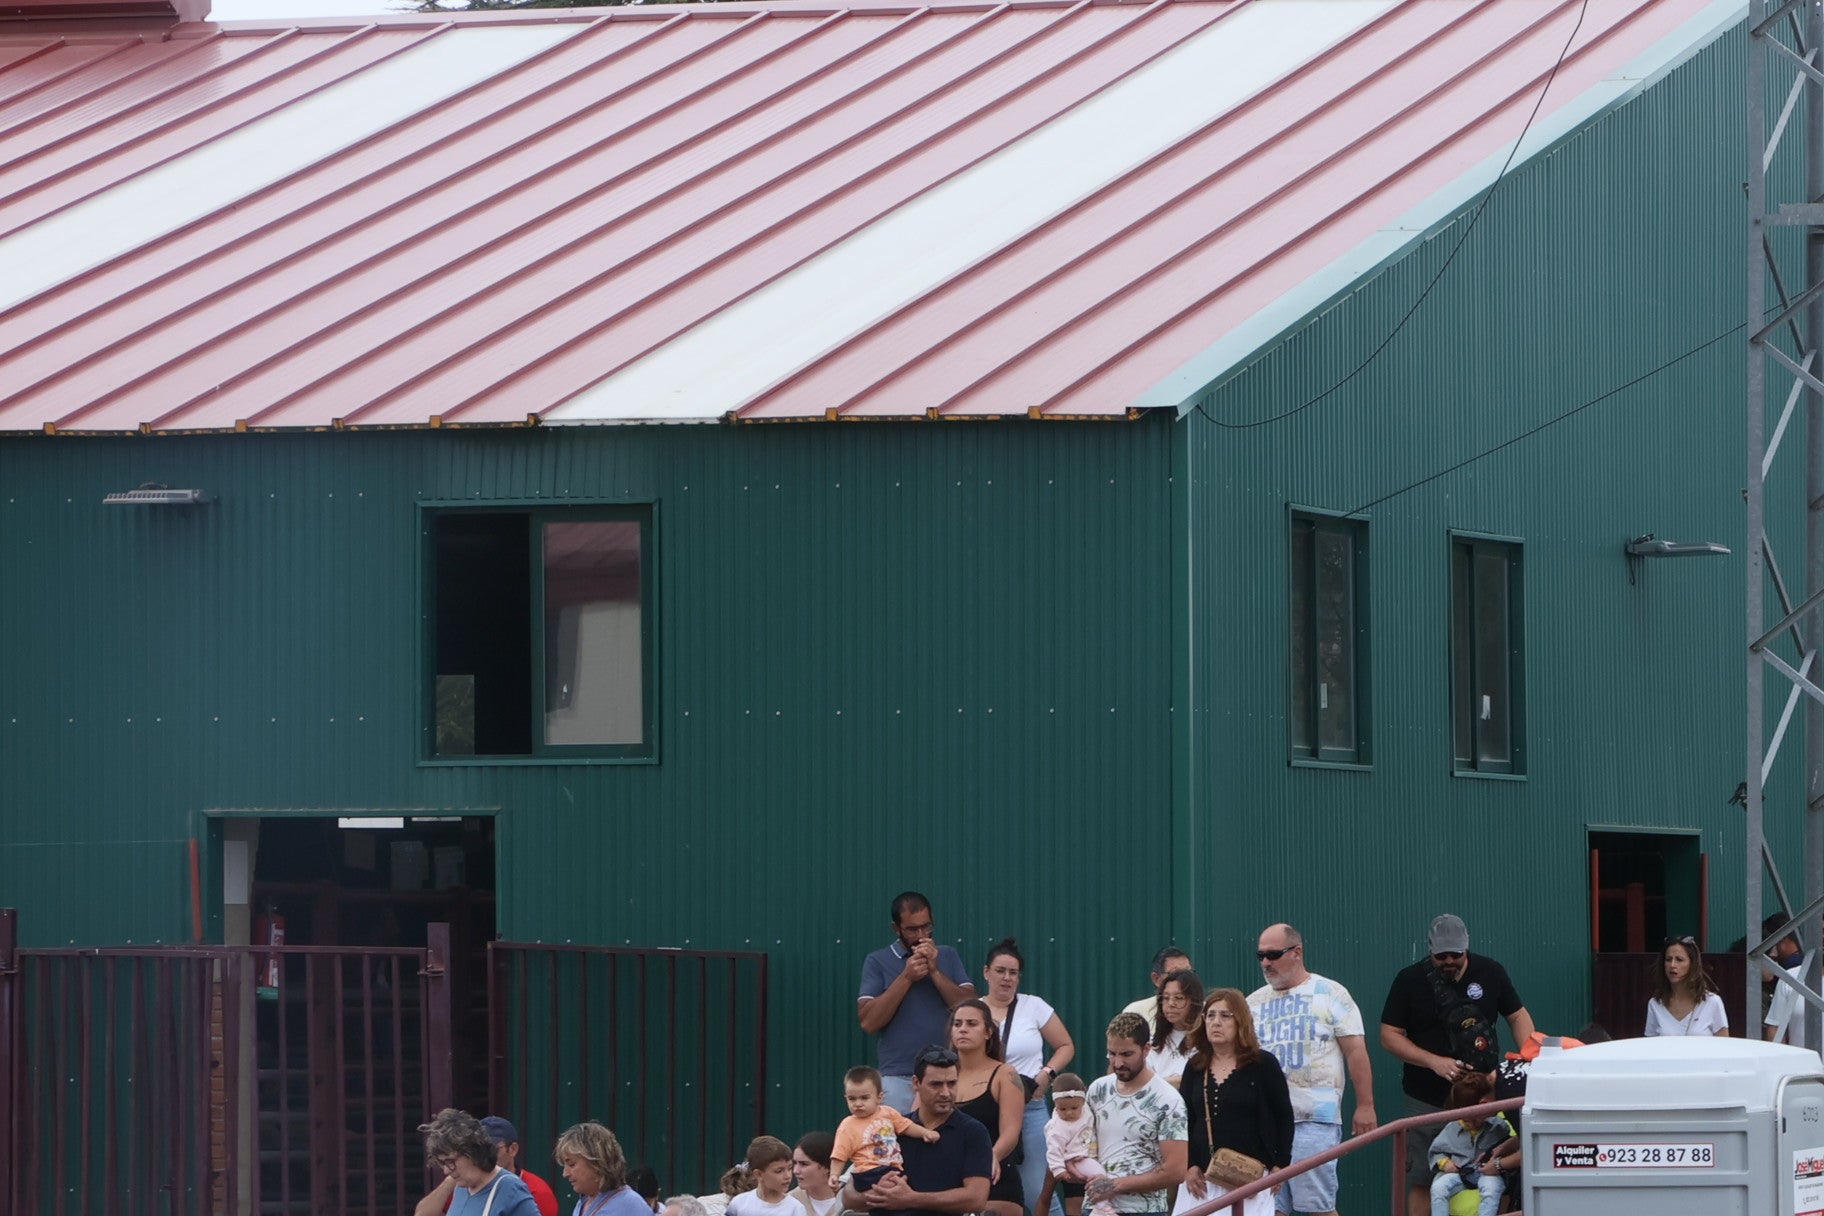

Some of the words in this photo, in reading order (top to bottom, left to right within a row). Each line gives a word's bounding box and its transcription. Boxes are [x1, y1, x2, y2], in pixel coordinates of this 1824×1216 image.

[1260, 993, 1309, 1021] HIGH
[1556, 1145, 1595, 1156] Alquiler
[1607, 1148, 1637, 1163] 923
[1642, 1148, 1661, 1163] 28
[1666, 1148, 1686, 1163] 87
[1691, 1148, 1711, 1162] 88
[1556, 1158, 1562, 1167] y
[1566, 1156, 1594, 1166] Venta
